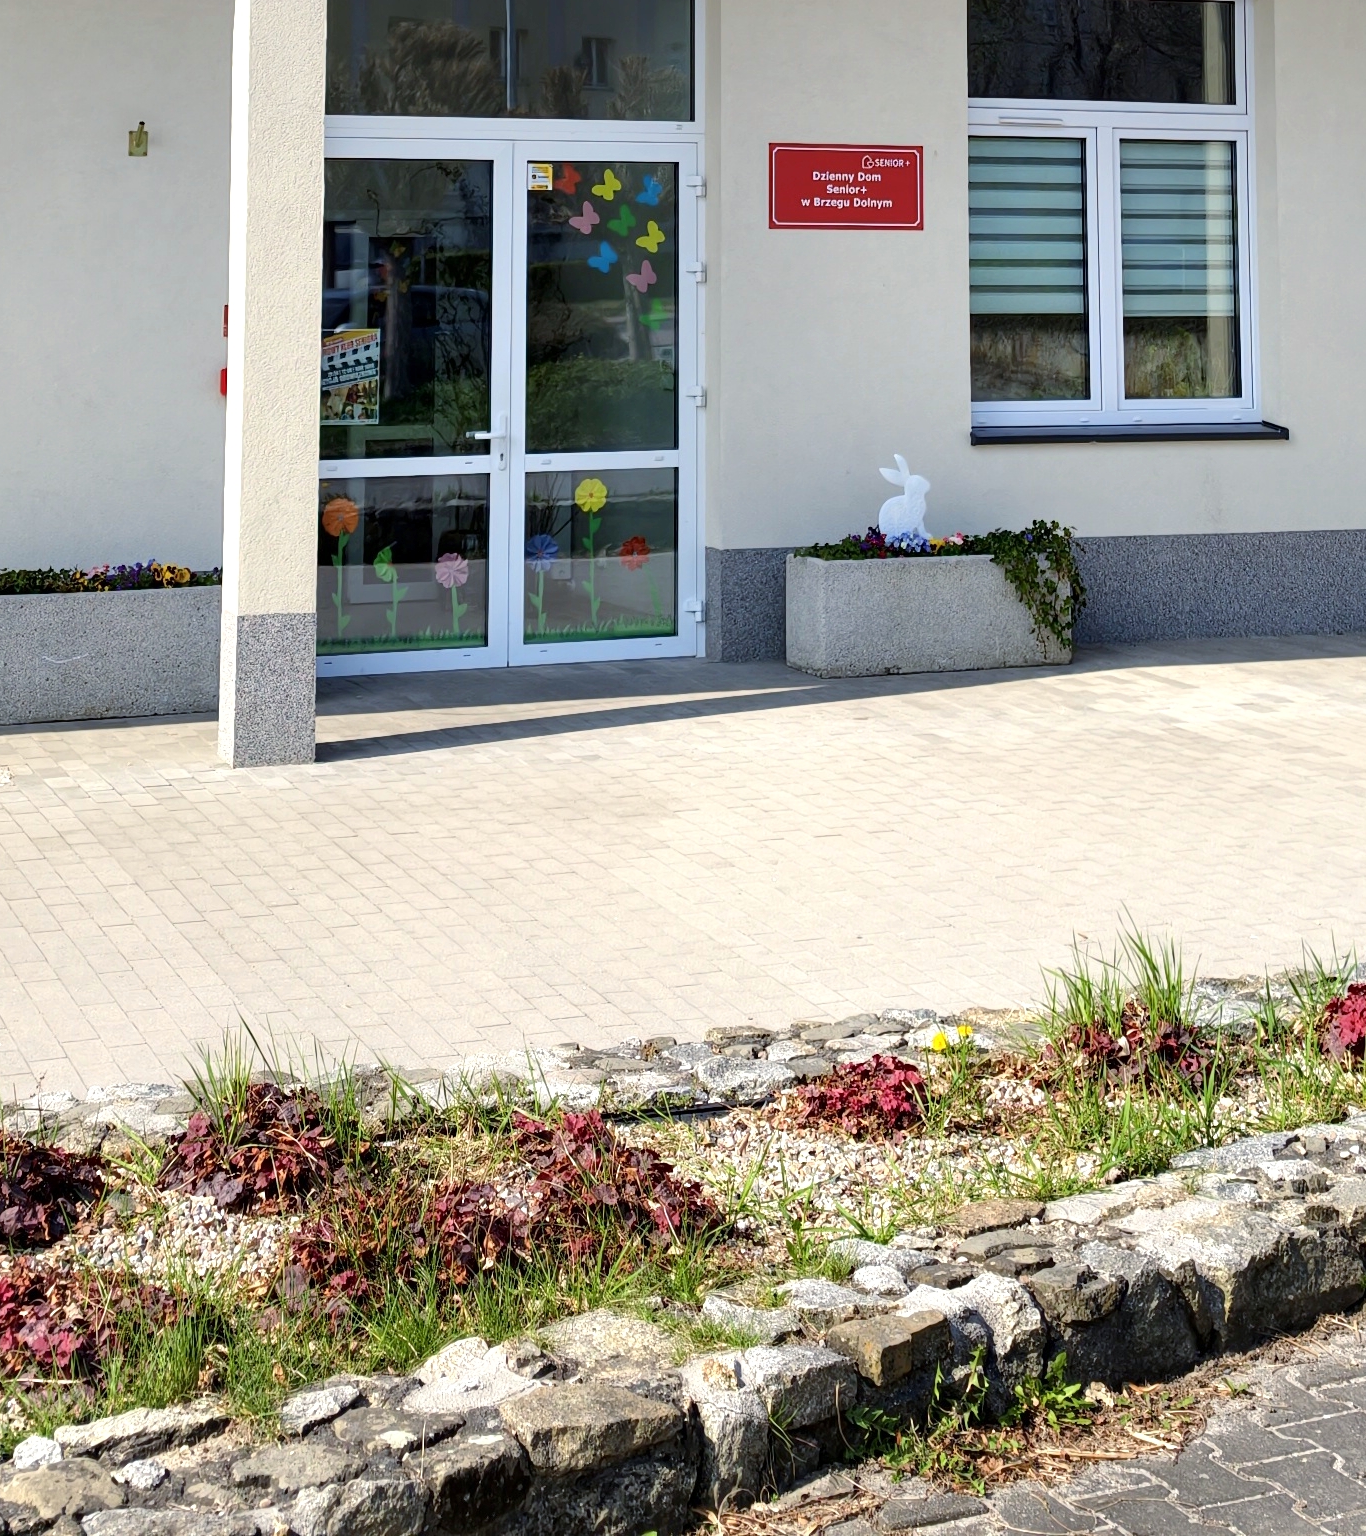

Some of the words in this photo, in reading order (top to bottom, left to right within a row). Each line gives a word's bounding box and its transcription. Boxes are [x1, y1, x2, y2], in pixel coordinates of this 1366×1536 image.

[812, 171, 854, 183] Dzienny
[857, 172, 882, 182] Dom
[826, 184, 867, 195] Senior+
[801, 198, 811, 207] w
[813, 197, 850, 209] Brzegu
[853, 198, 893, 210] Dolnym
